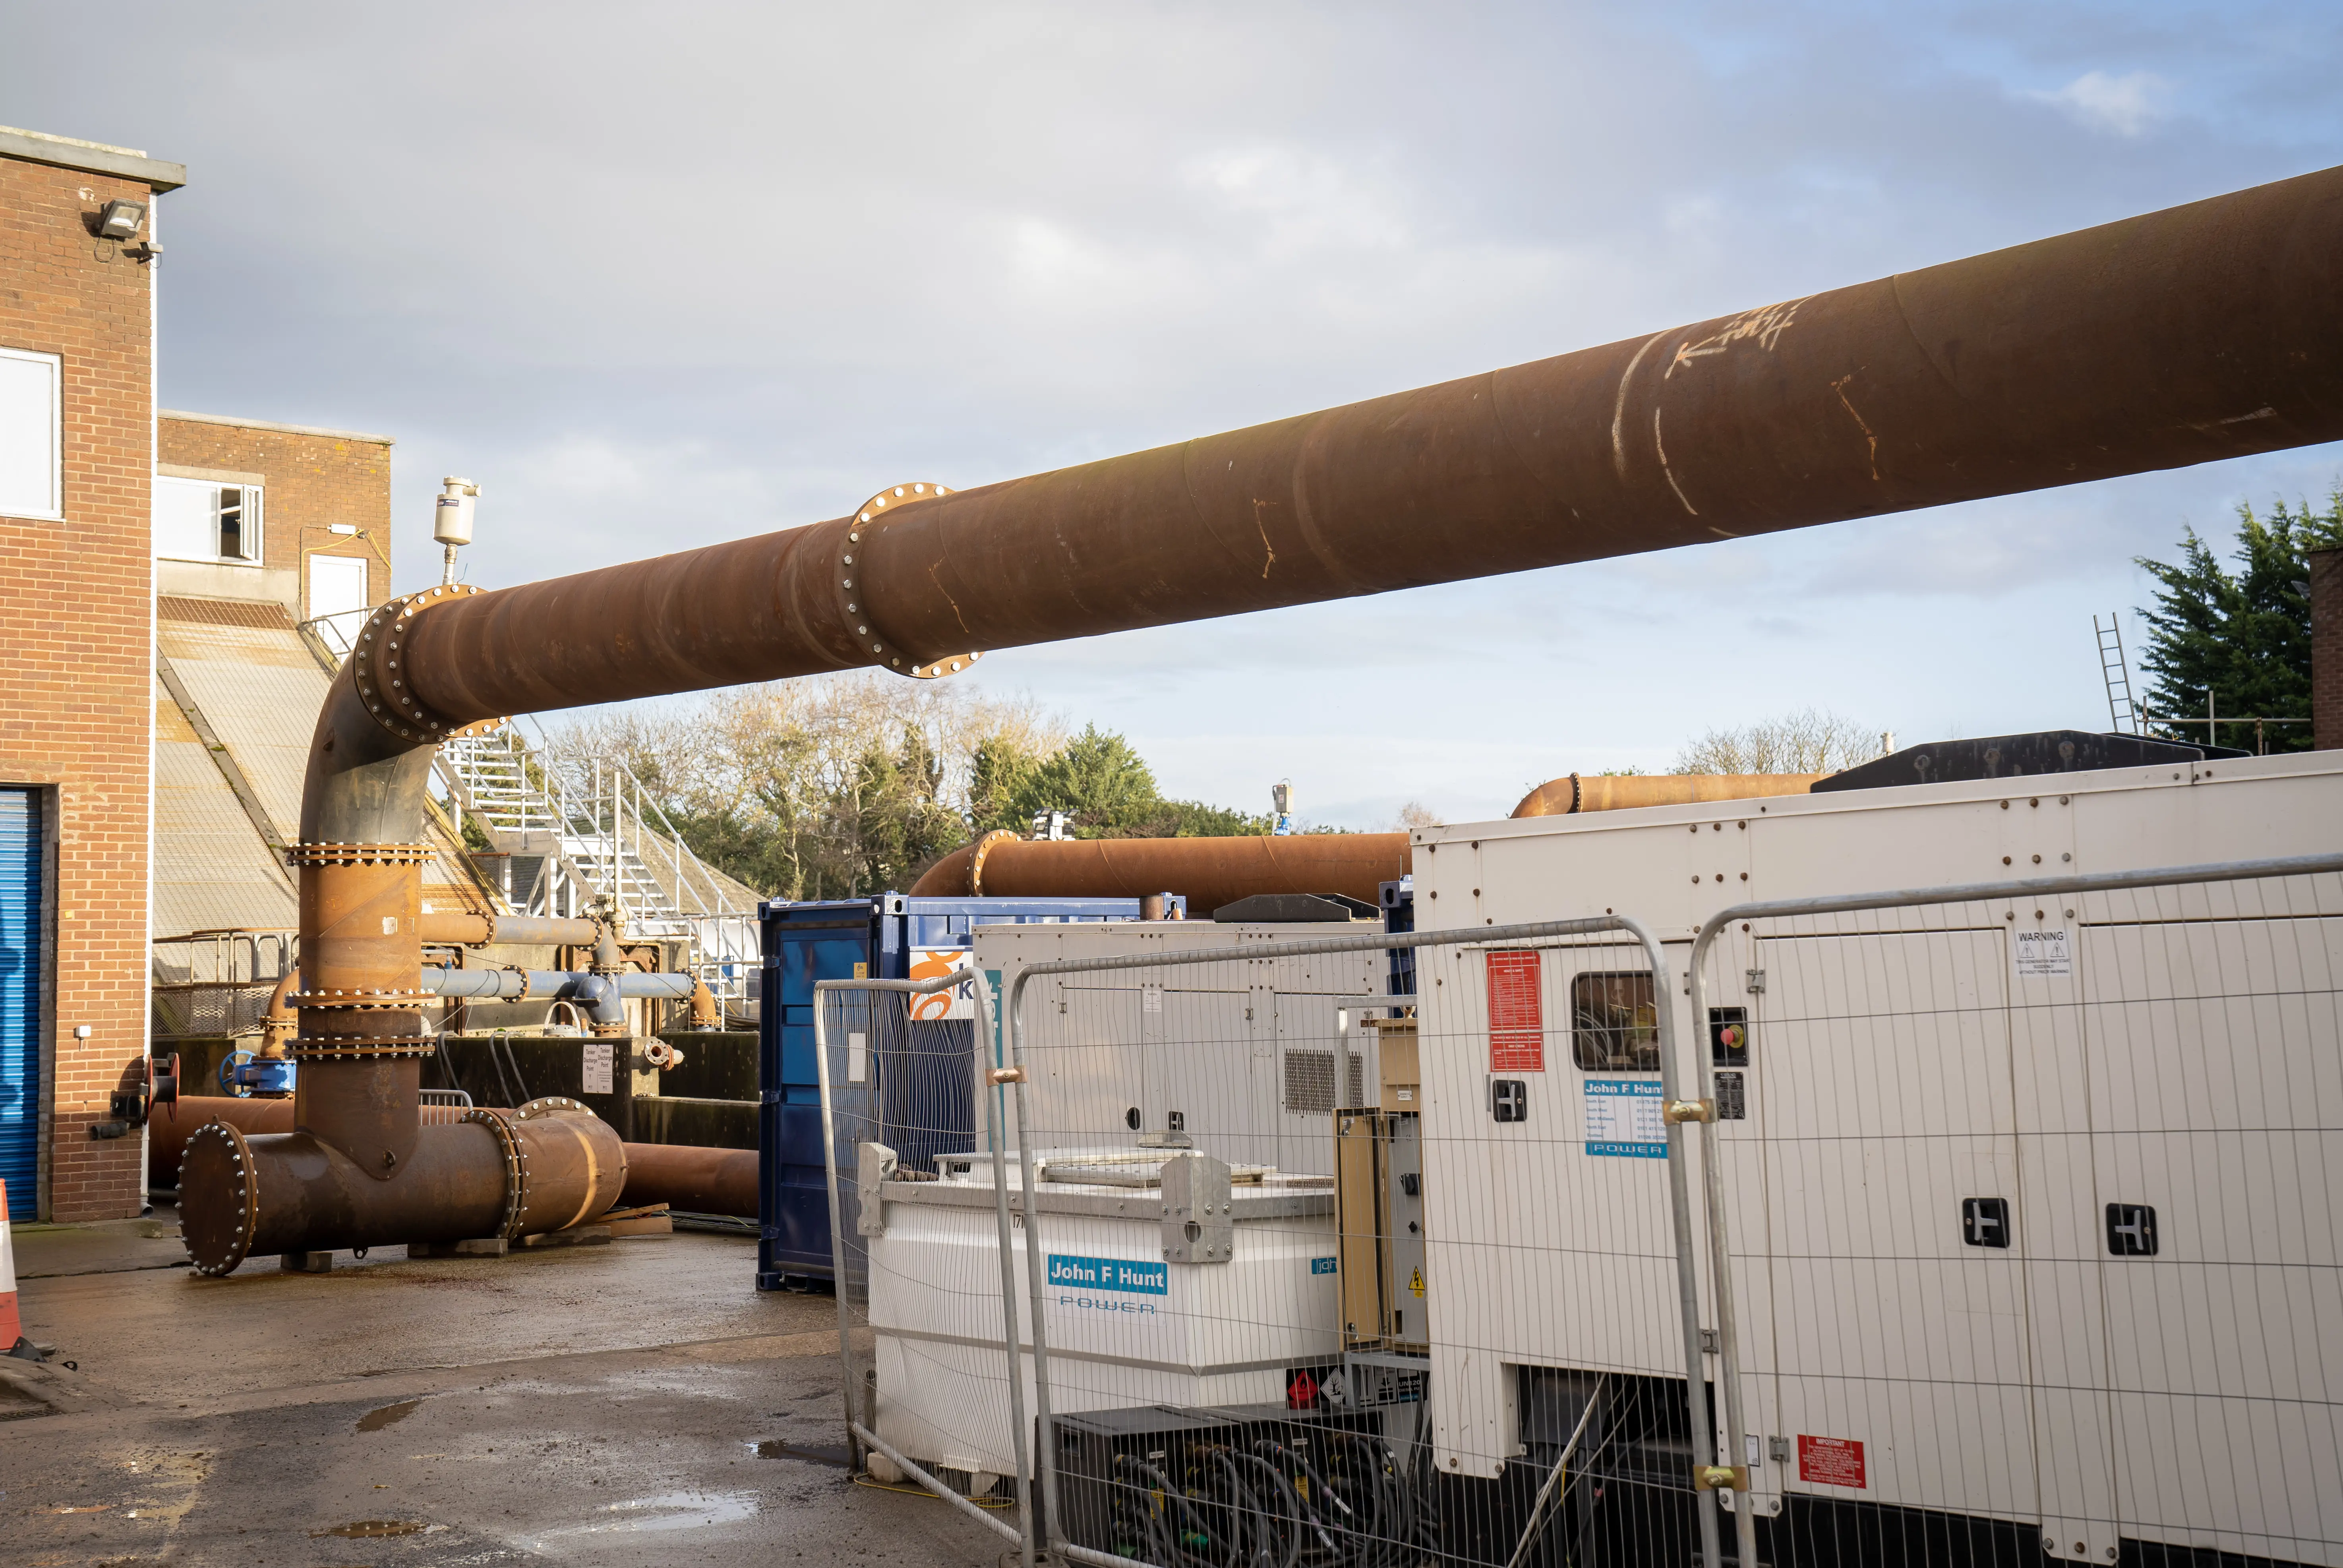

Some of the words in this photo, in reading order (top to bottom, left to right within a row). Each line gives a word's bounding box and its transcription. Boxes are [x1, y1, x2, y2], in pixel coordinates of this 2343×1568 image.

[2018, 932, 2064, 941] WARNING
[1586, 1083, 1617, 1092] John
[1622, 1084, 1629, 1093] F
[1634, 1084, 1663, 1094] Hun
[1594, 1144, 1662, 1154] POWER
[1013, 1214, 1025, 1229] 171
[1051, 1262, 1095, 1281] John
[1101, 1266, 1111, 1282] F
[1120, 1267, 1164, 1287] Hunt
[1060, 1296, 1154, 1315] POWER
[1816, 1438, 1845, 1447] IMPORTANT
